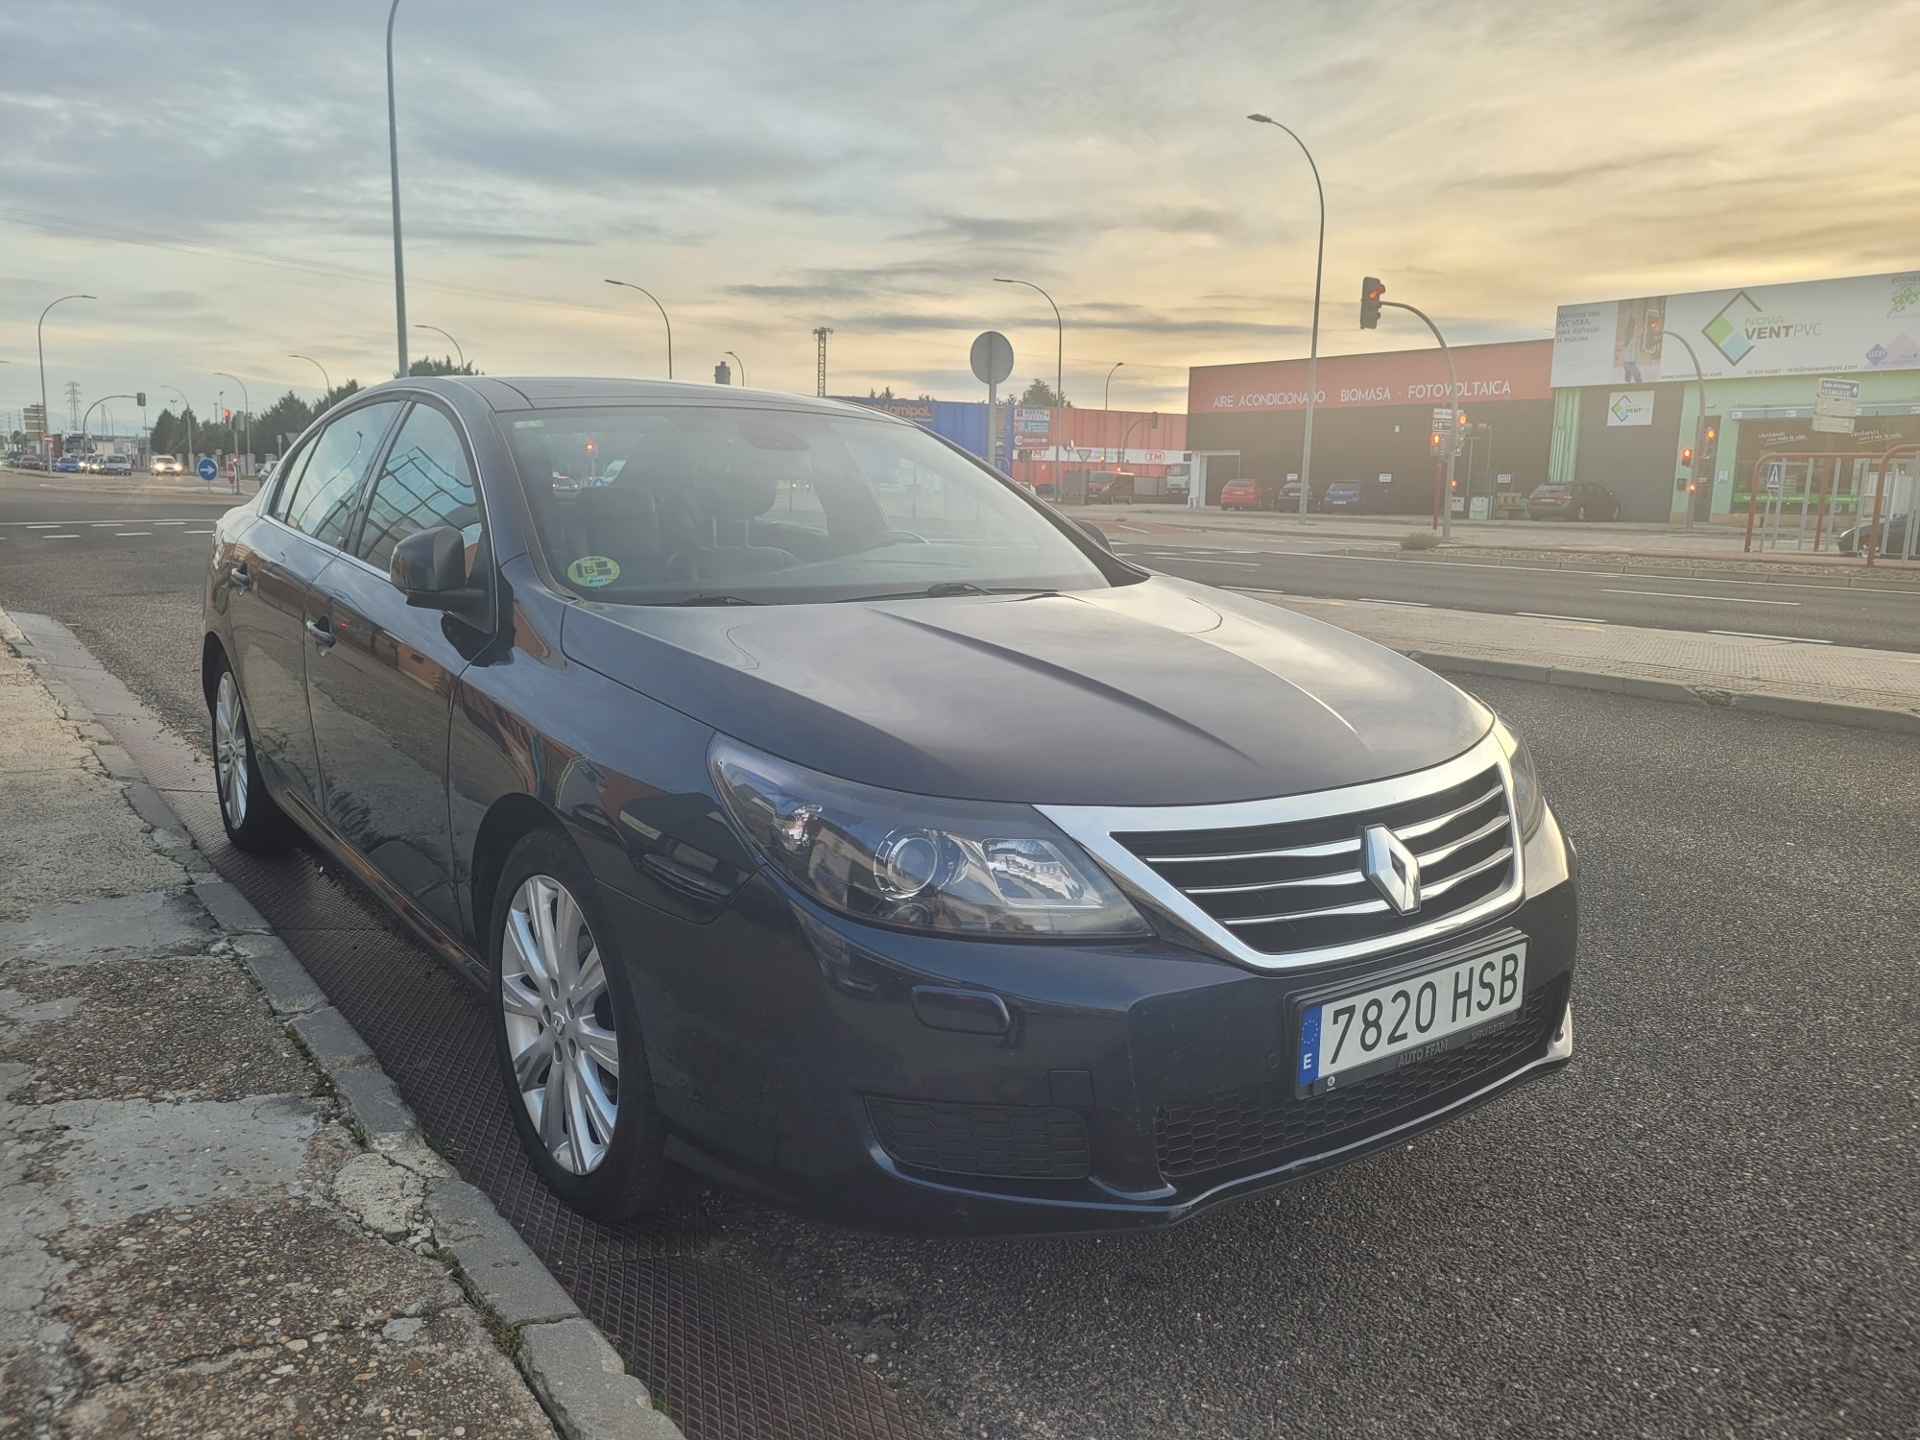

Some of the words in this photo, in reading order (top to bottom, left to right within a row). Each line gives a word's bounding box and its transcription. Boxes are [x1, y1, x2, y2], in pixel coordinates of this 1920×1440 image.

[1558, 312, 1587, 320] Ventanas
[1745, 315, 1784, 326] NOVA
[1558, 319, 1572, 328] PVC
[1557, 328, 1571, 337] para
[1572, 326, 1599, 335] disfrutar
[1563, 335, 1589, 343] máximo
[1213, 395, 1234, 408] AIRE
[1340, 386, 1391, 402] BIOMASA
[1408, 380, 1511, 399] FOTOVOLTAICA
[1758, 431, 1786, 440] Ventanas
[1148, 453, 1162, 461] IM
[584, 565, 595, 574] B
[1330, 980, 1437, 1066] 7820
[1451, 952, 1519, 1023] HSB
[1303, 1052, 1313, 1070] E
[1397, 1048, 1424, 1068] AUTO
